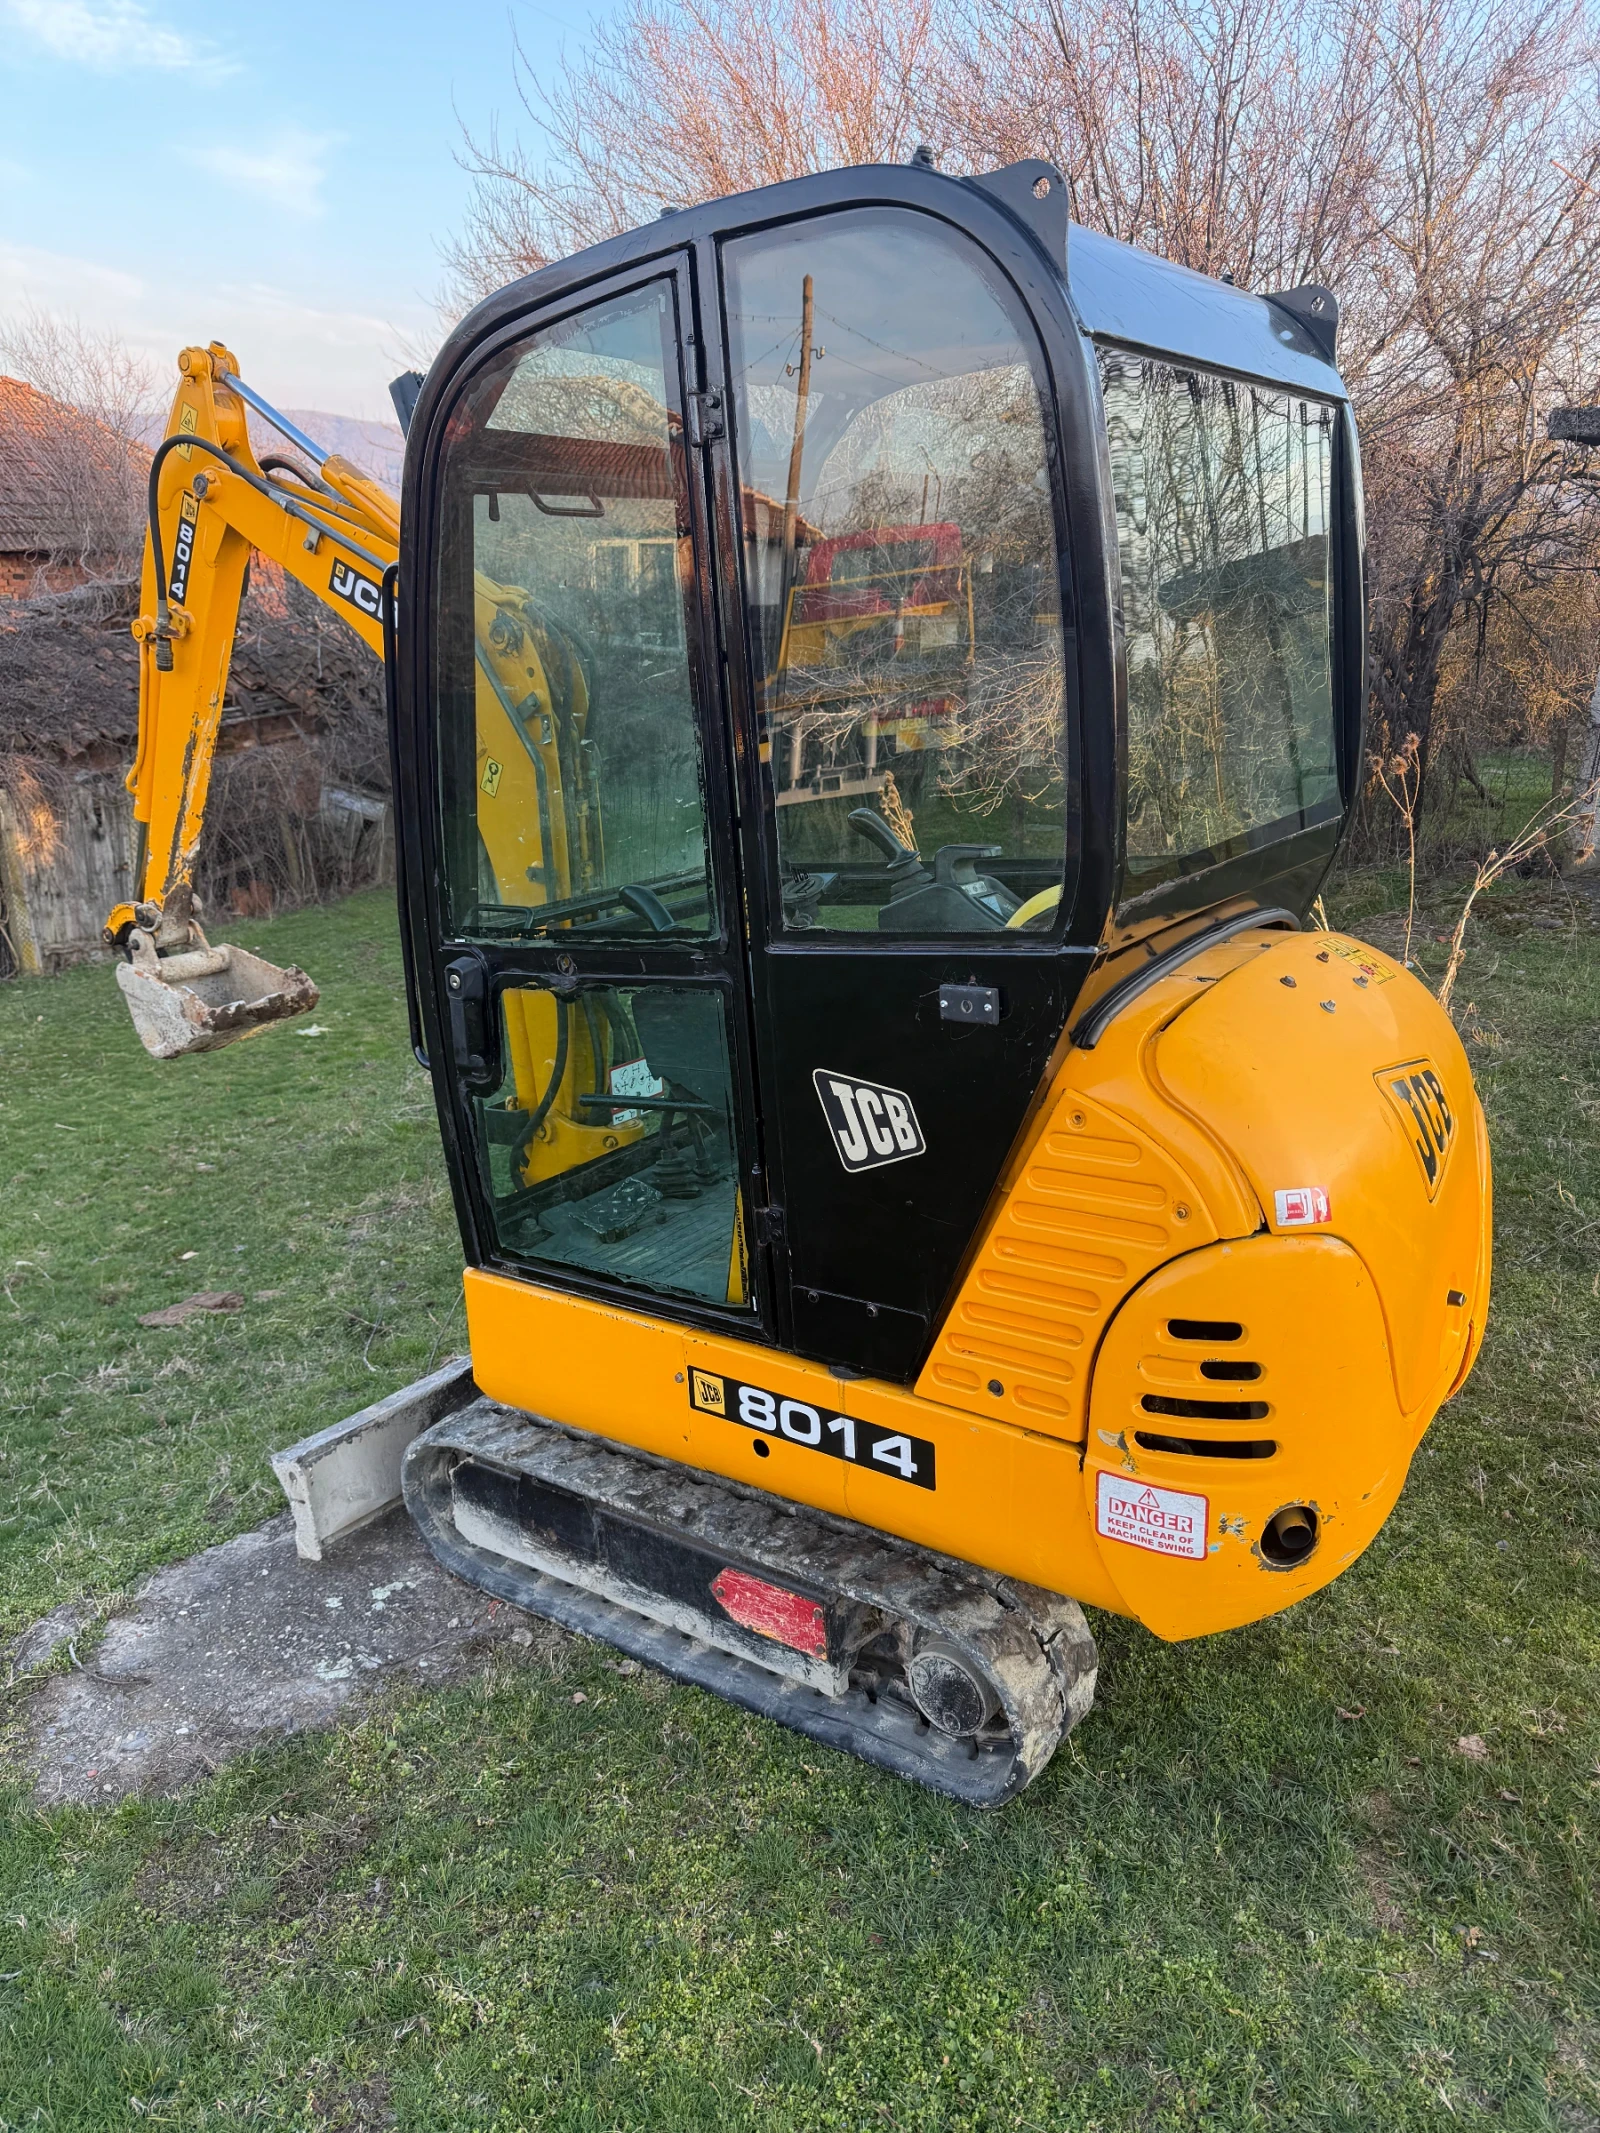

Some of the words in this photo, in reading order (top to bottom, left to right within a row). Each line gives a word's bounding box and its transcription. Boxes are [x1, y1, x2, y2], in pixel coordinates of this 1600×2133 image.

[171, 524, 194, 600] 8014
[333, 571, 398, 628] JC
[829, 1080, 918, 1162] JCB
[1391, 1070, 1454, 1187] JCB
[700, 1380, 721, 1402] JCB
[738, 1386, 918, 1478] 8014
[1107, 1516, 1136, 1531] KEEP
[1139, 1526, 1176, 1542] CLEAR
[1178, 1536, 1194, 1545] OF
[1107, 1526, 1155, 1547] MACHINE
[1157, 1541, 1195, 1555] SWING
[1111, 1500, 1192, 1533] DANGER
